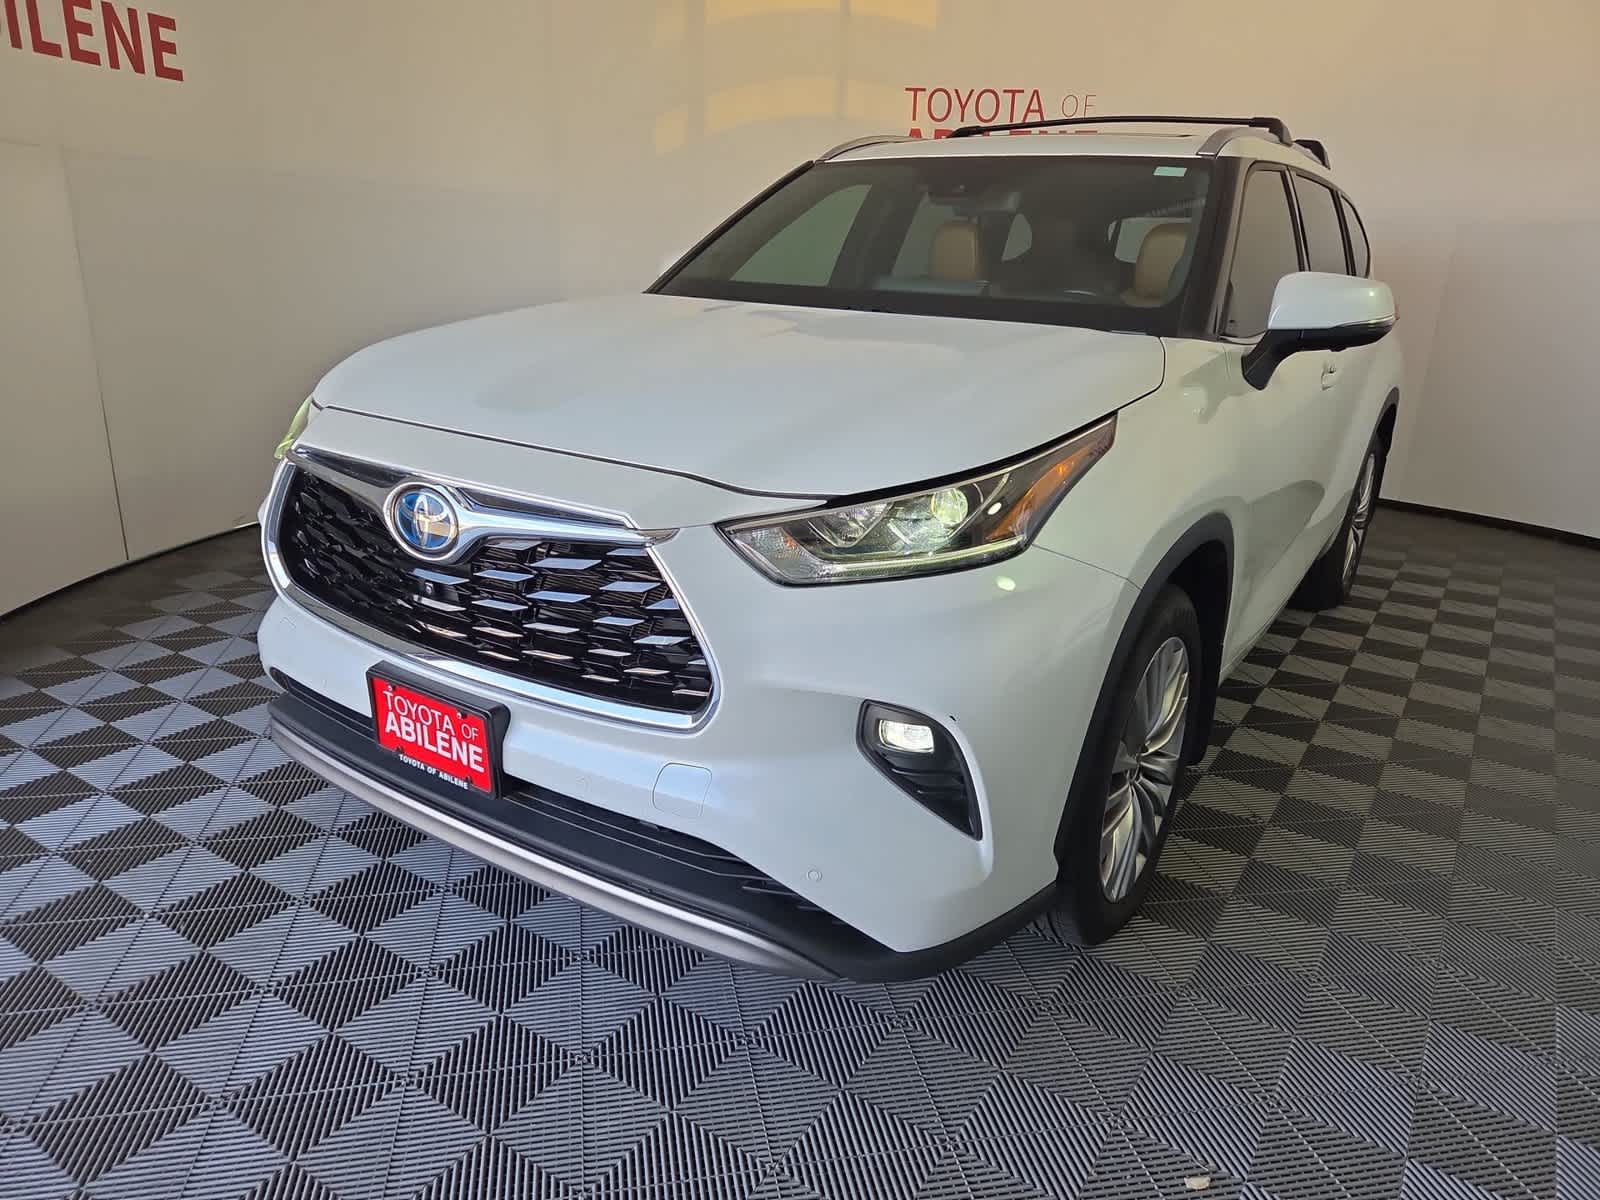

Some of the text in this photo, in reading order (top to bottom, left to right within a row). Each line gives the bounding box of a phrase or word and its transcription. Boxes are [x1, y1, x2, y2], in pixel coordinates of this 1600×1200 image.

[0, 0, 184, 82] ILENE
[905, 87, 1097, 123] TOYOTA OF
[383, 690, 479, 740] TOYOTA OF
[385, 711, 485, 773] ABILENE
[399, 753, 469, 790] TOYOTA OF ABILENE
